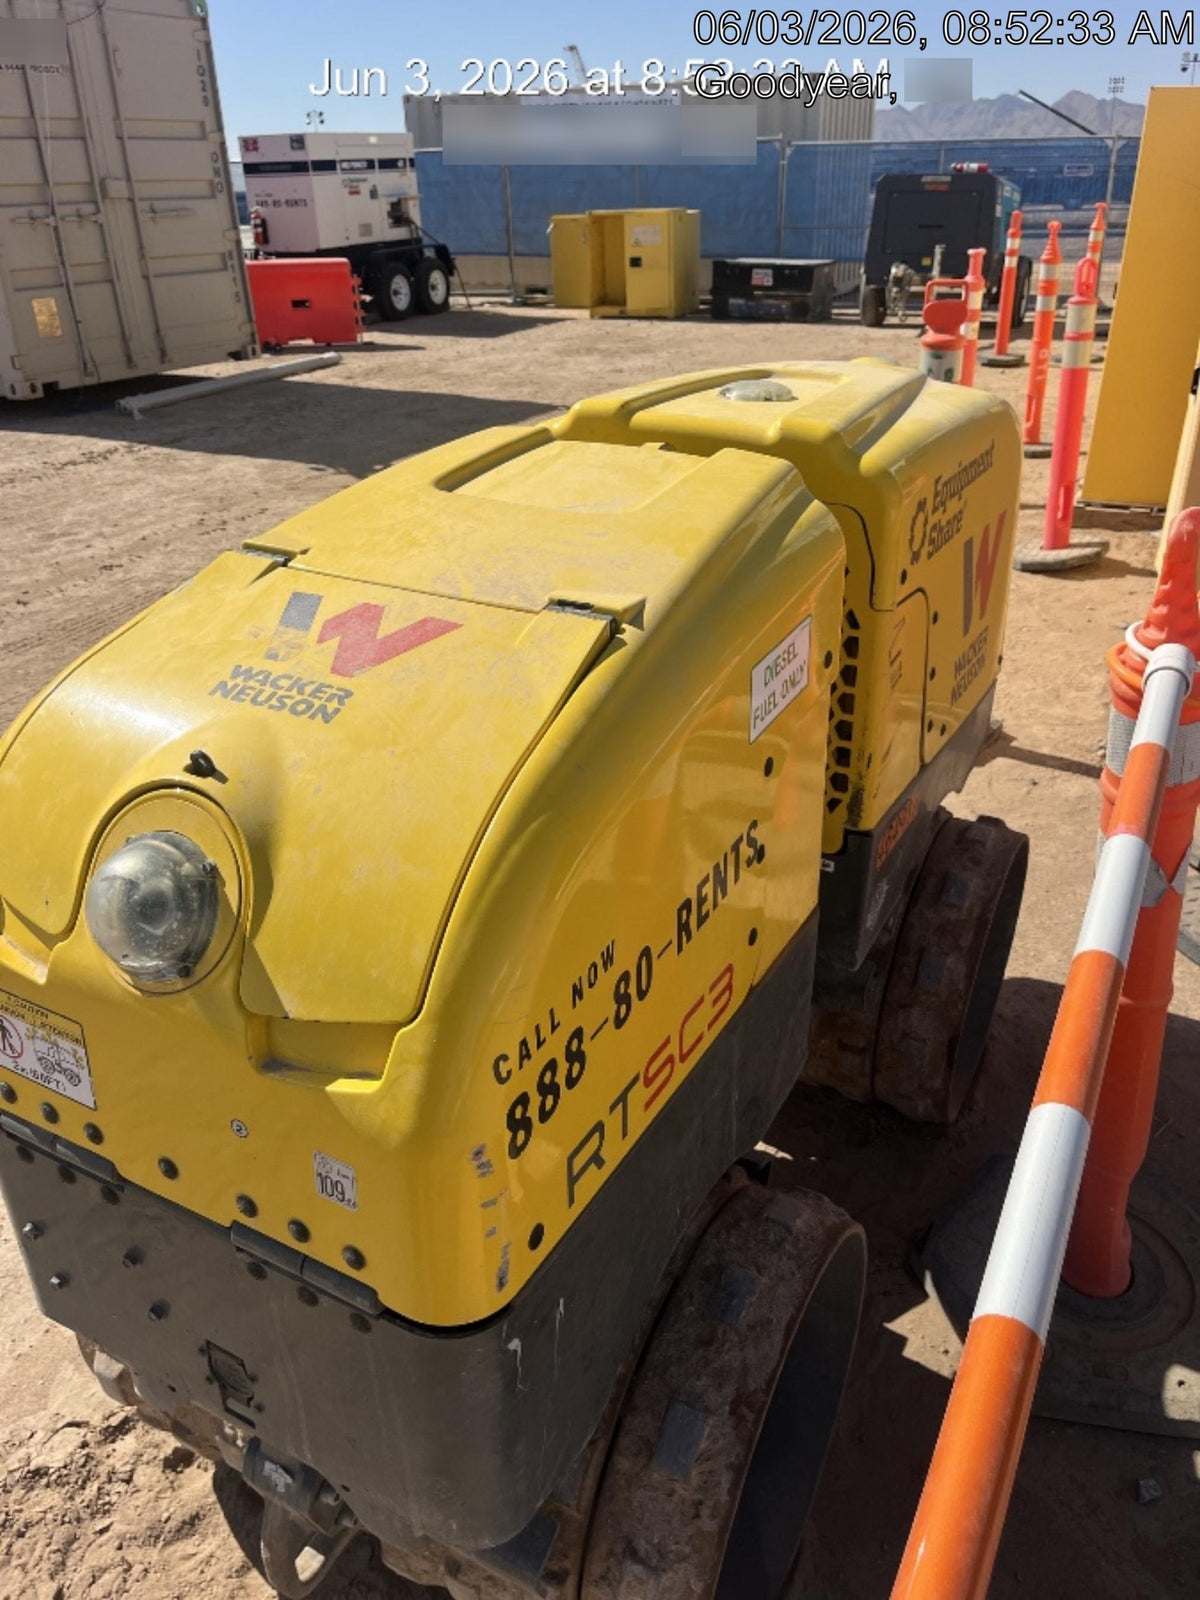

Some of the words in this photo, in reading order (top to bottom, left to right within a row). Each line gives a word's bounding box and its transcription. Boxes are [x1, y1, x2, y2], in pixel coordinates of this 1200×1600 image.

[931, 440, 994, 515] Equipment
[927, 509, 963, 560] Share
[764, 641, 798, 688] DIESEL
[954, 626, 988, 678] WACKER
[208, 680, 341, 724] NEUSON
[231, 664, 354, 706] WACKER
[753, 690, 779, 730] FUEL
[492, 1006, 560, 1085] CALL
[571, 939, 616, 1009] NOW
[316, 1172, 346, 1203] 109
